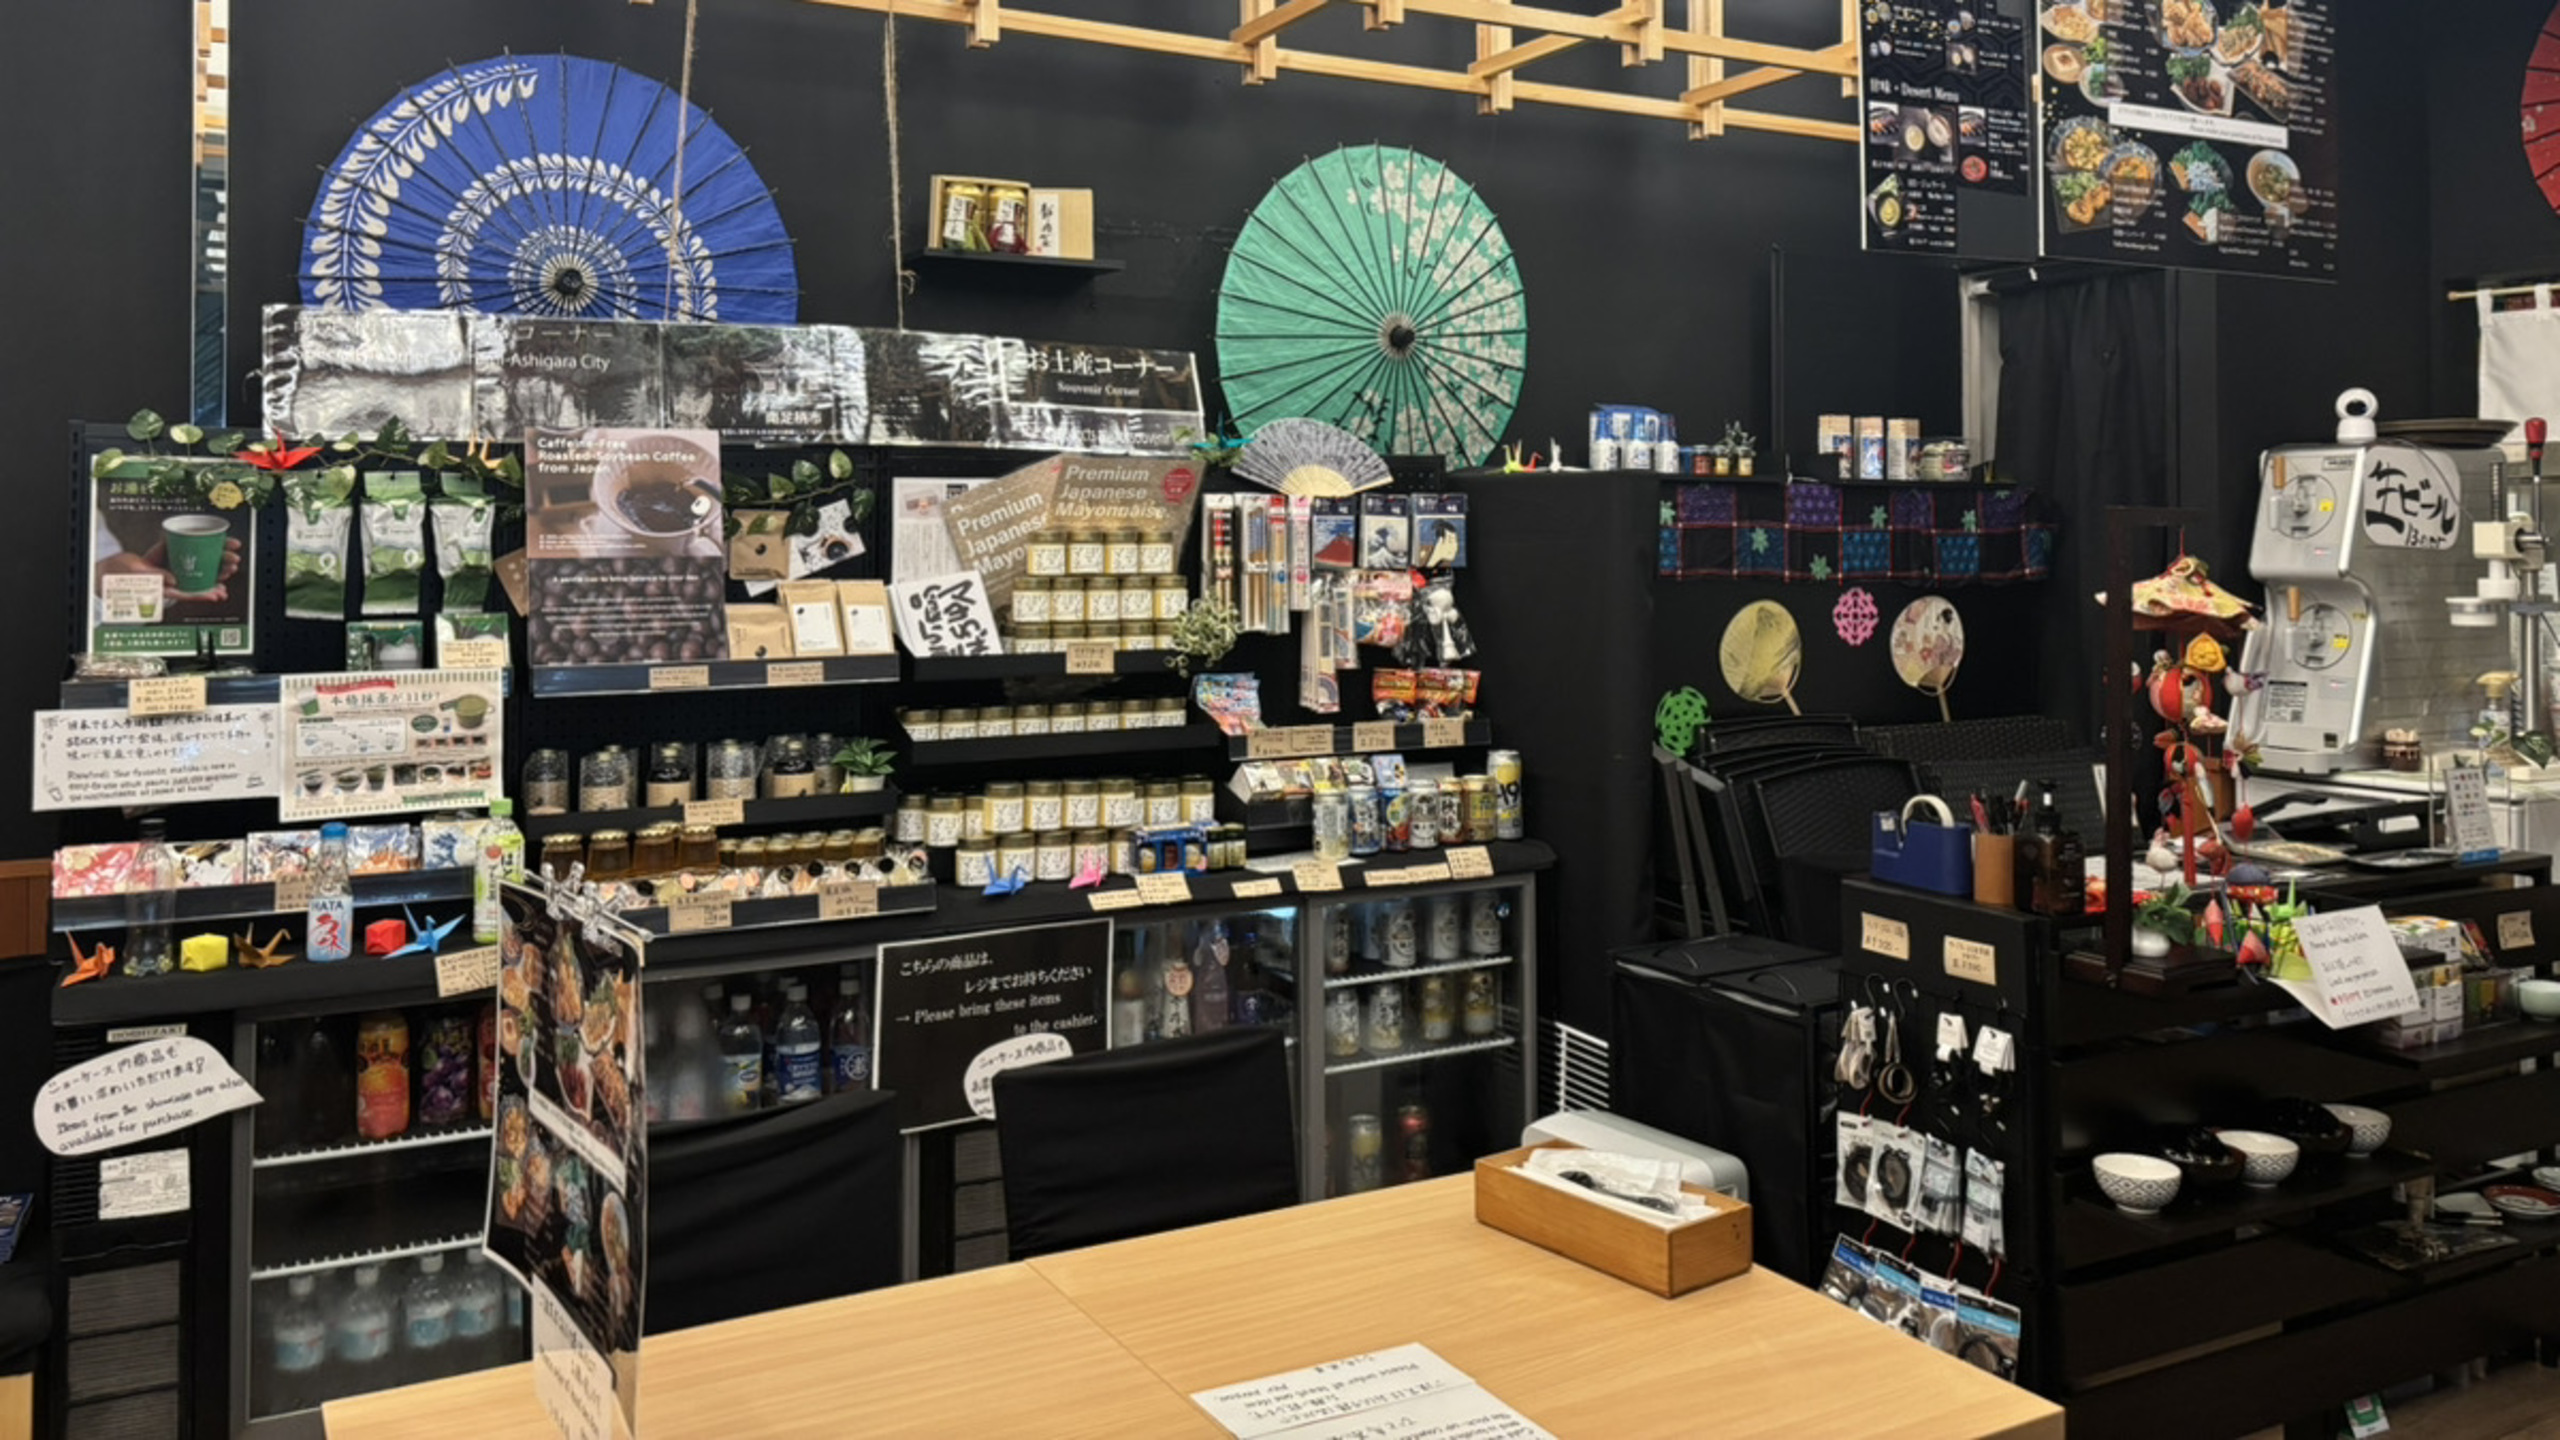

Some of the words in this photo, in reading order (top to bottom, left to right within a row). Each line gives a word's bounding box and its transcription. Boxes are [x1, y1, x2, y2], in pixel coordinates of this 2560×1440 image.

[580, 352, 611, 371] City
[1027, 345, 1176, 378] お土産コーナー
[1105, 384, 1140, 396] Corner
[537, 437, 627, 450] Caffeine-Free
[652, 451, 697, 463] Coffee
[538, 463, 570, 474] from
[1064, 464, 1149, 482] Premium
[1060, 484, 1148, 502] Japanese
[957, 492, 1044, 538] Premium
[964, 965, 1093, 994] レジまでお持ちください
[914, 1006, 955, 1025] Please
[958, 1002, 991, 1019] bring
[994, 996, 1027, 1012] these
[1029, 993, 1062, 1007] items
[1013, 1022, 1026, 1035] to
[1029, 1018, 1050, 1033] the
[1052, 1012, 1098, 1030] cashier.
[56, 1117, 88, 1136] Items
[94, 1109, 118, 1124] from
[122, 1103, 138, 1116] the
[195, 1085, 215, 1097] are
[59, 1127, 115, 1152] available
[118, 1119, 137, 1133] for
